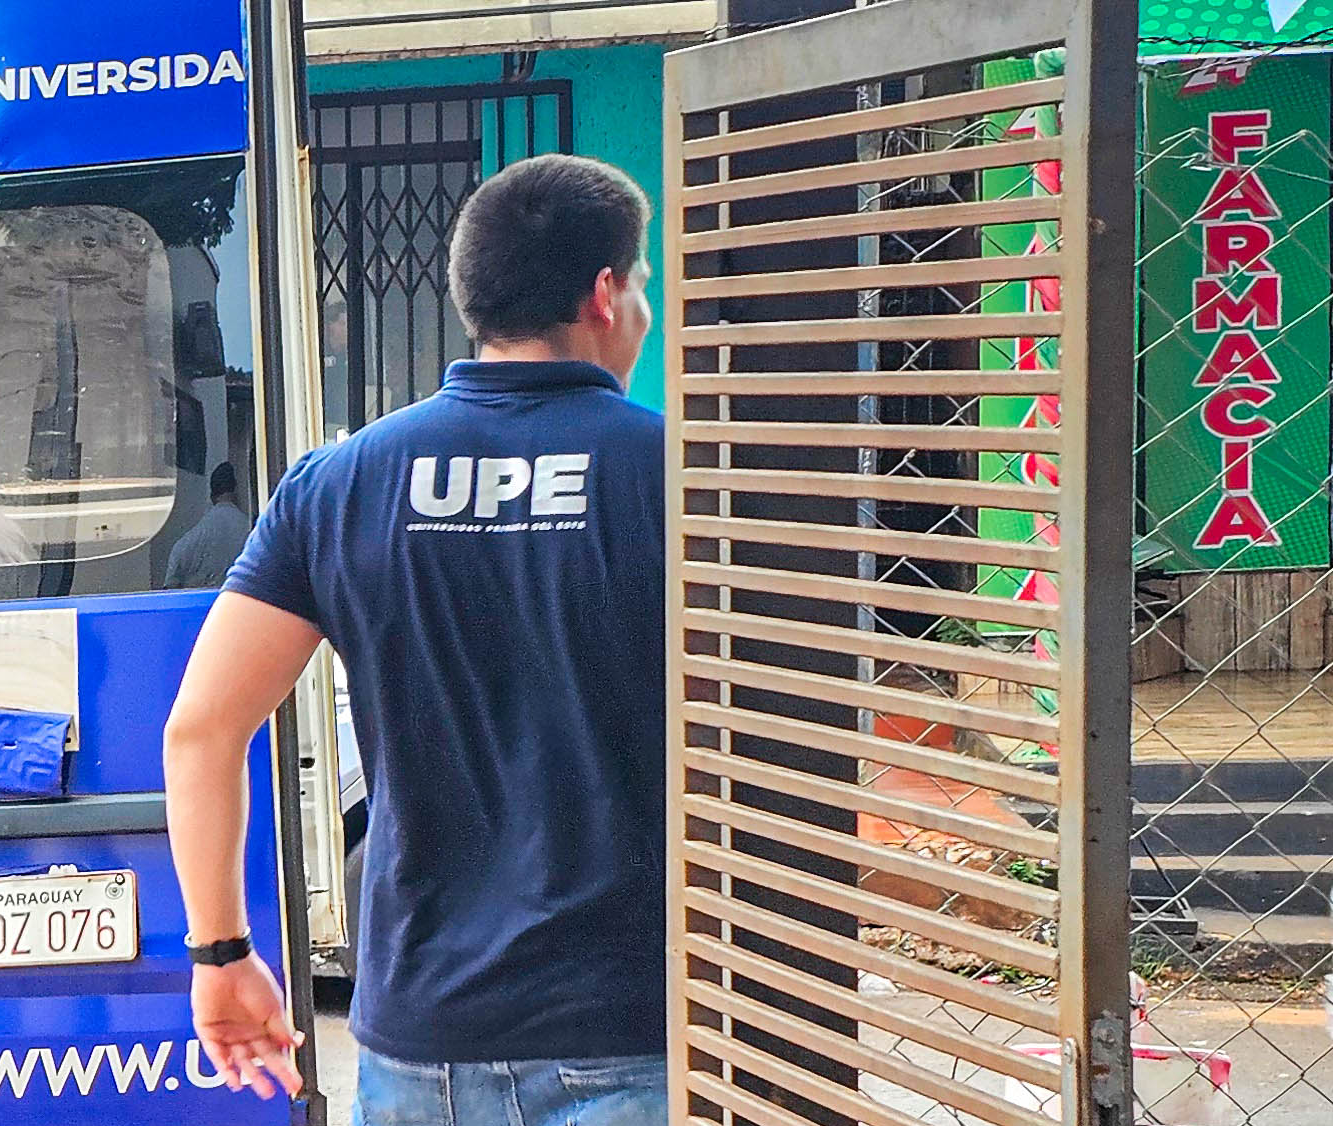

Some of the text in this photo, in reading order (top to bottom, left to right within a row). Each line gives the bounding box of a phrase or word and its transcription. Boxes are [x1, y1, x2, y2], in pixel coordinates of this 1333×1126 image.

[1192, 109, 1282, 549] FARMACIA
[409, 454, 591, 518] UPE
[48, 908, 116, 953] 076
